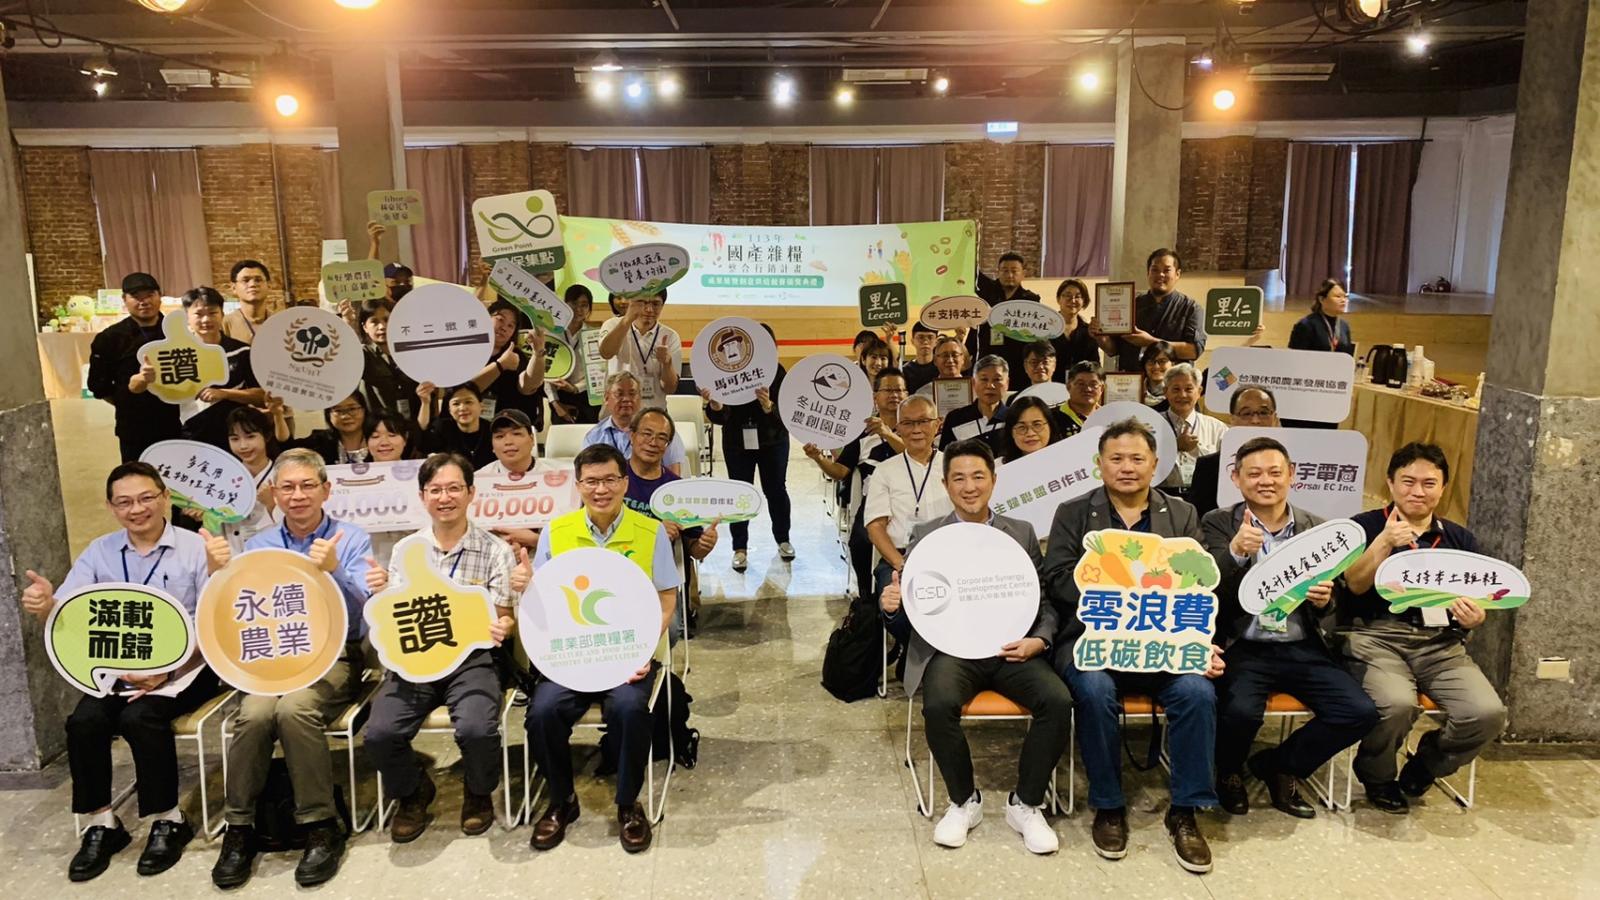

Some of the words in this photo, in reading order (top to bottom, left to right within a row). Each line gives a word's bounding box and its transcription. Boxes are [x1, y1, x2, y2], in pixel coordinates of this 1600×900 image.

[492, 244, 513, 253] Green
[514, 242, 533, 250] Point
[501, 251, 555, 267] 保集點
[727, 244, 803, 262] 國產雜糧
[868, 291, 901, 312] 里仁
[1213, 296, 1252, 318] 里仁
[867, 312, 901, 321] Leezen
[928, 308, 982, 321] #支持本土
[1213, 319, 1251, 328] Leezen
[157, 348, 201, 385] 讚
[714, 367, 766, 391] 馬可先生
[797, 394, 851, 422] 冬山良食
[791, 410, 847, 437] 農創園區
[187, 455, 224, 479] 多食用
[1290, 462, 1359, 482] 宇電商
[993, 467, 1090, 515] 主婦聯盟合作社
[1323, 483, 1336, 491] EC
[1338, 484, 1356, 492] Inc.
[471, 495, 554, 520] 10,000
[1402, 569, 1503, 586] 支持本土雜糧
[88, 599, 154, 630] 滿載
[234, 584, 307, 622] 永續
[1079, 589, 1217, 635] 零浪費
[392, 593, 458, 654] 讚
[88, 630, 154, 661] 而歸
[239, 621, 312, 663] 農業
[550, 629, 635, 652] 農業部農糧署
[1076, 638, 1211, 672] 低碳飲食
